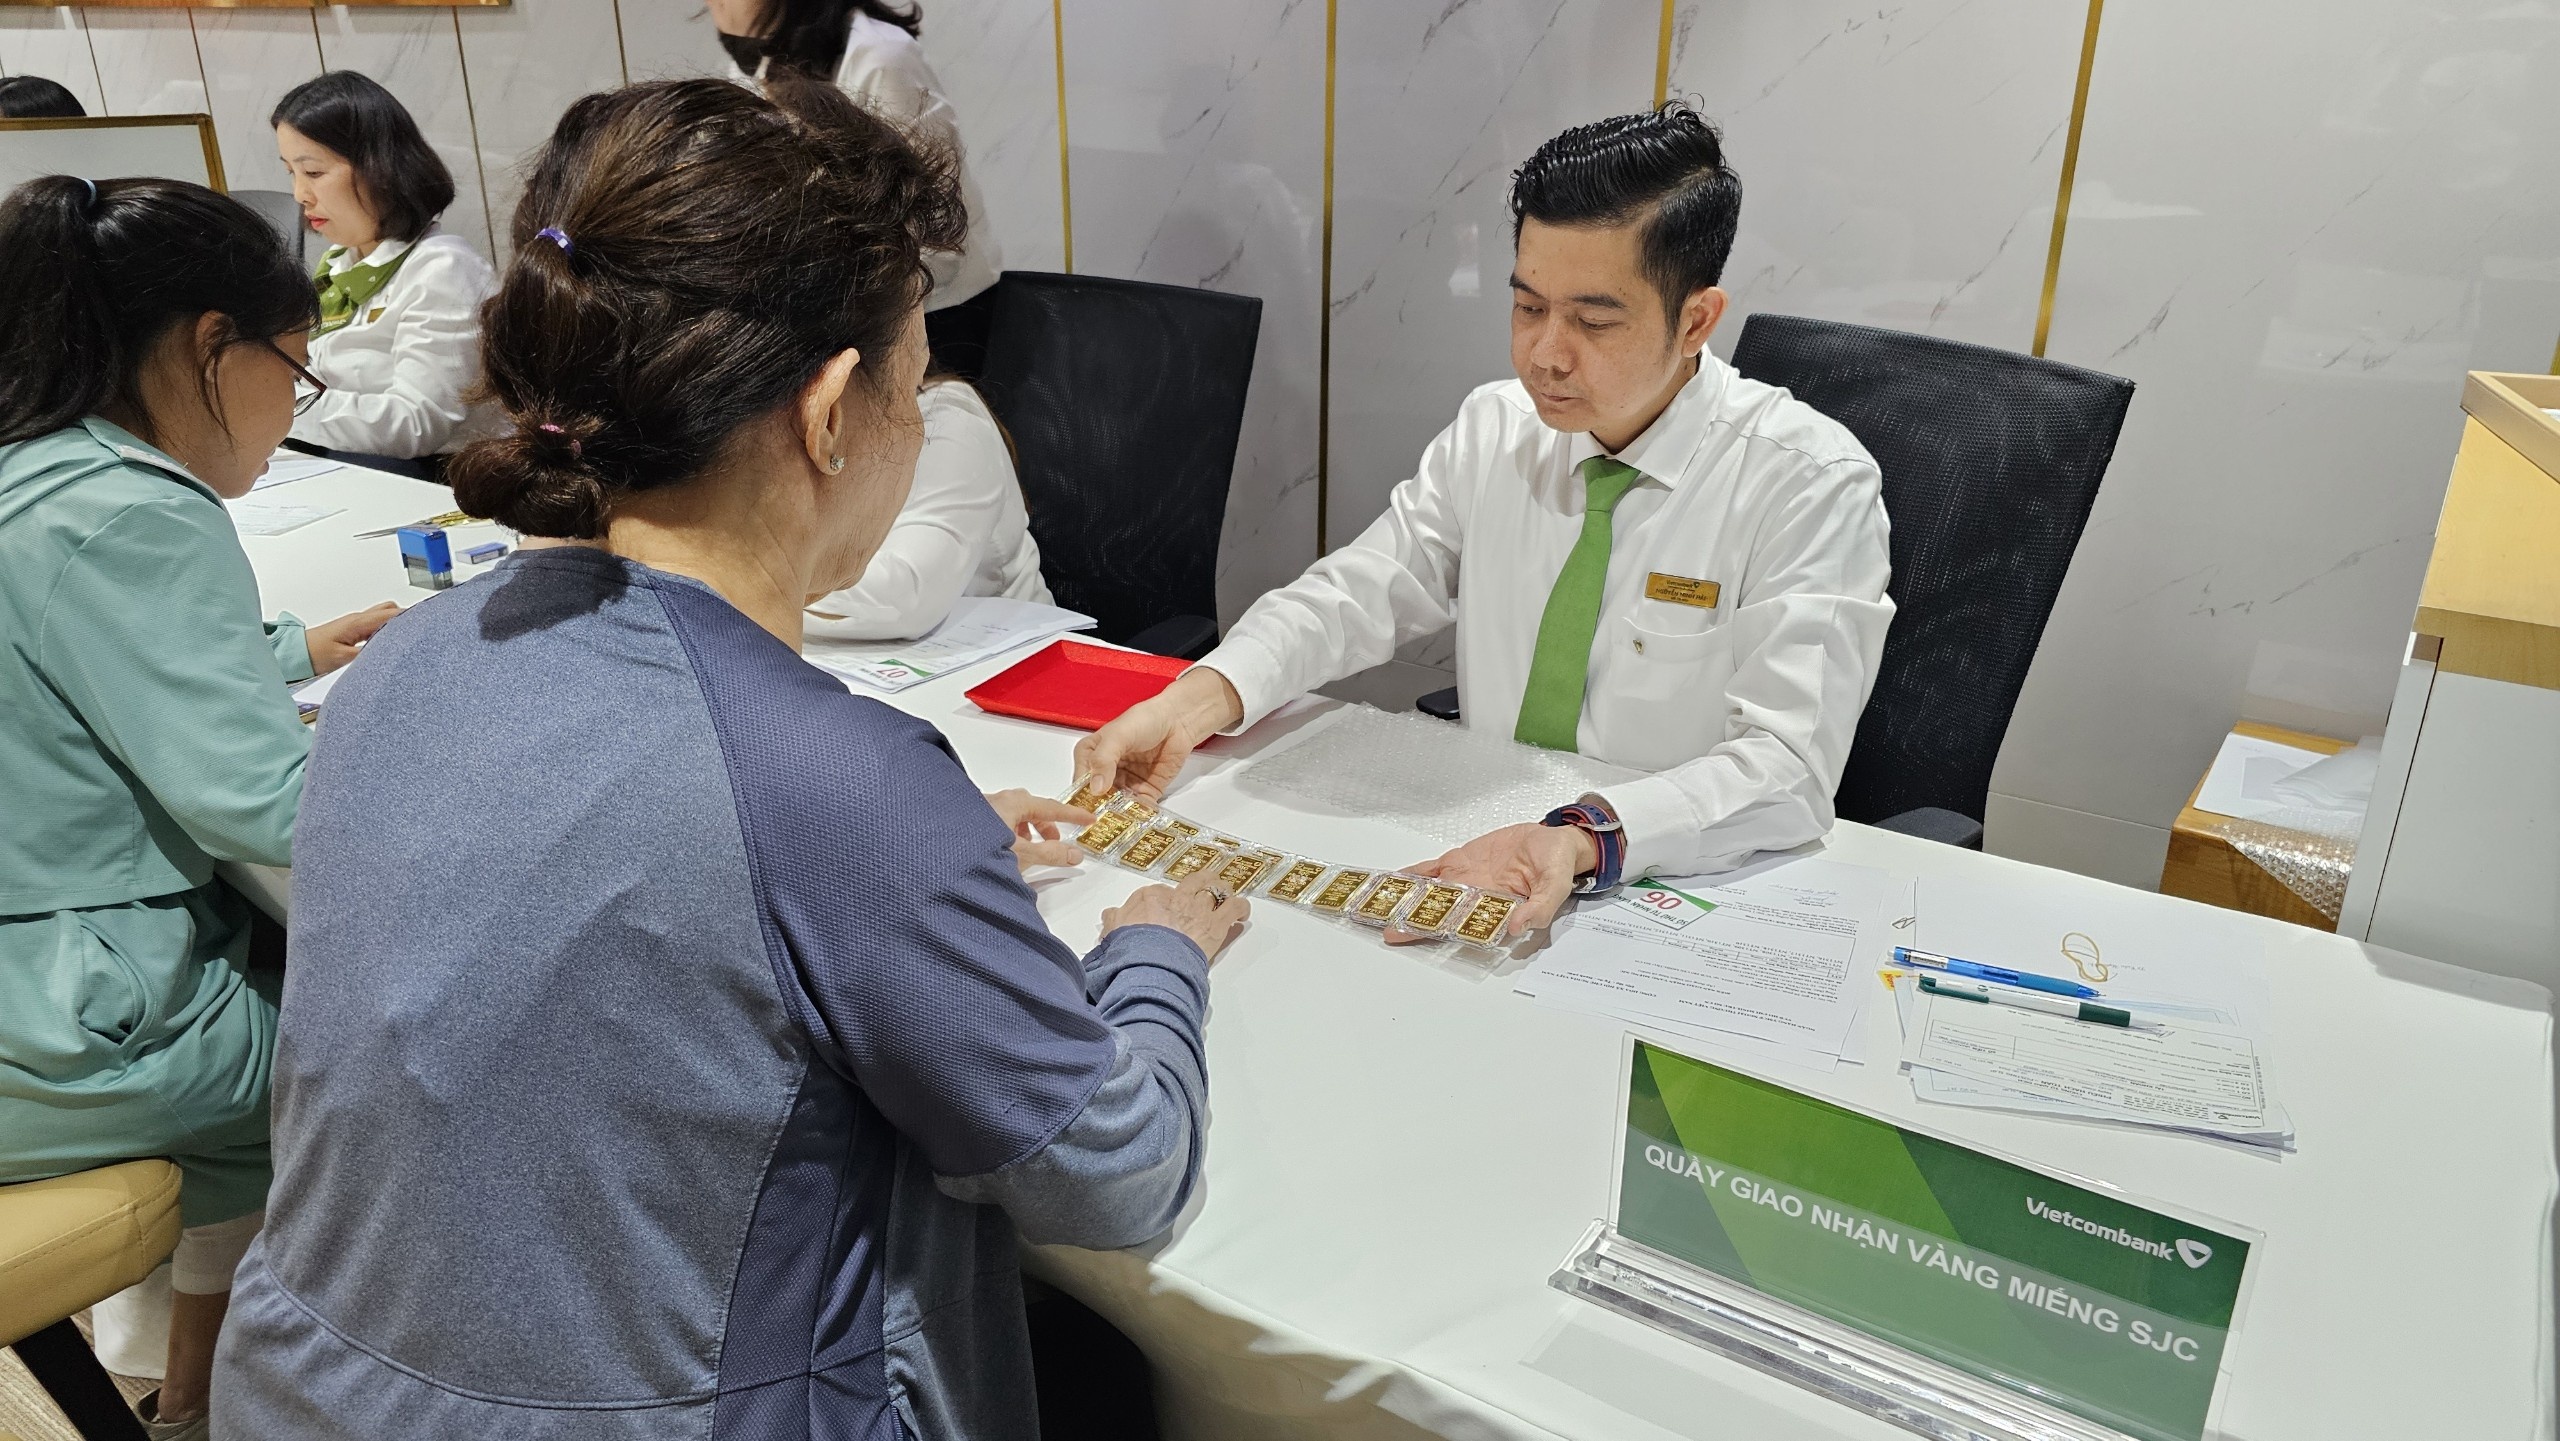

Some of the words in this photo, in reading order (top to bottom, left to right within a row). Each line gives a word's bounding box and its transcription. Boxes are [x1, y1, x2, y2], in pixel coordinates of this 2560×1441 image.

[1640, 891, 1682, 909] 06
[1645, 1145, 1725, 1188] QUẦY
[1730, 1176, 1804, 1217] GIAO
[1811, 1204, 1899, 1254] NHẬN
[1907, 1238, 1999, 1290] VÀNG
[2007, 1275, 2119, 1333] MIẾNG
[2128, 1320, 2199, 1361] SJC
[2026, 1196, 2174, 1261] Vietcombank
